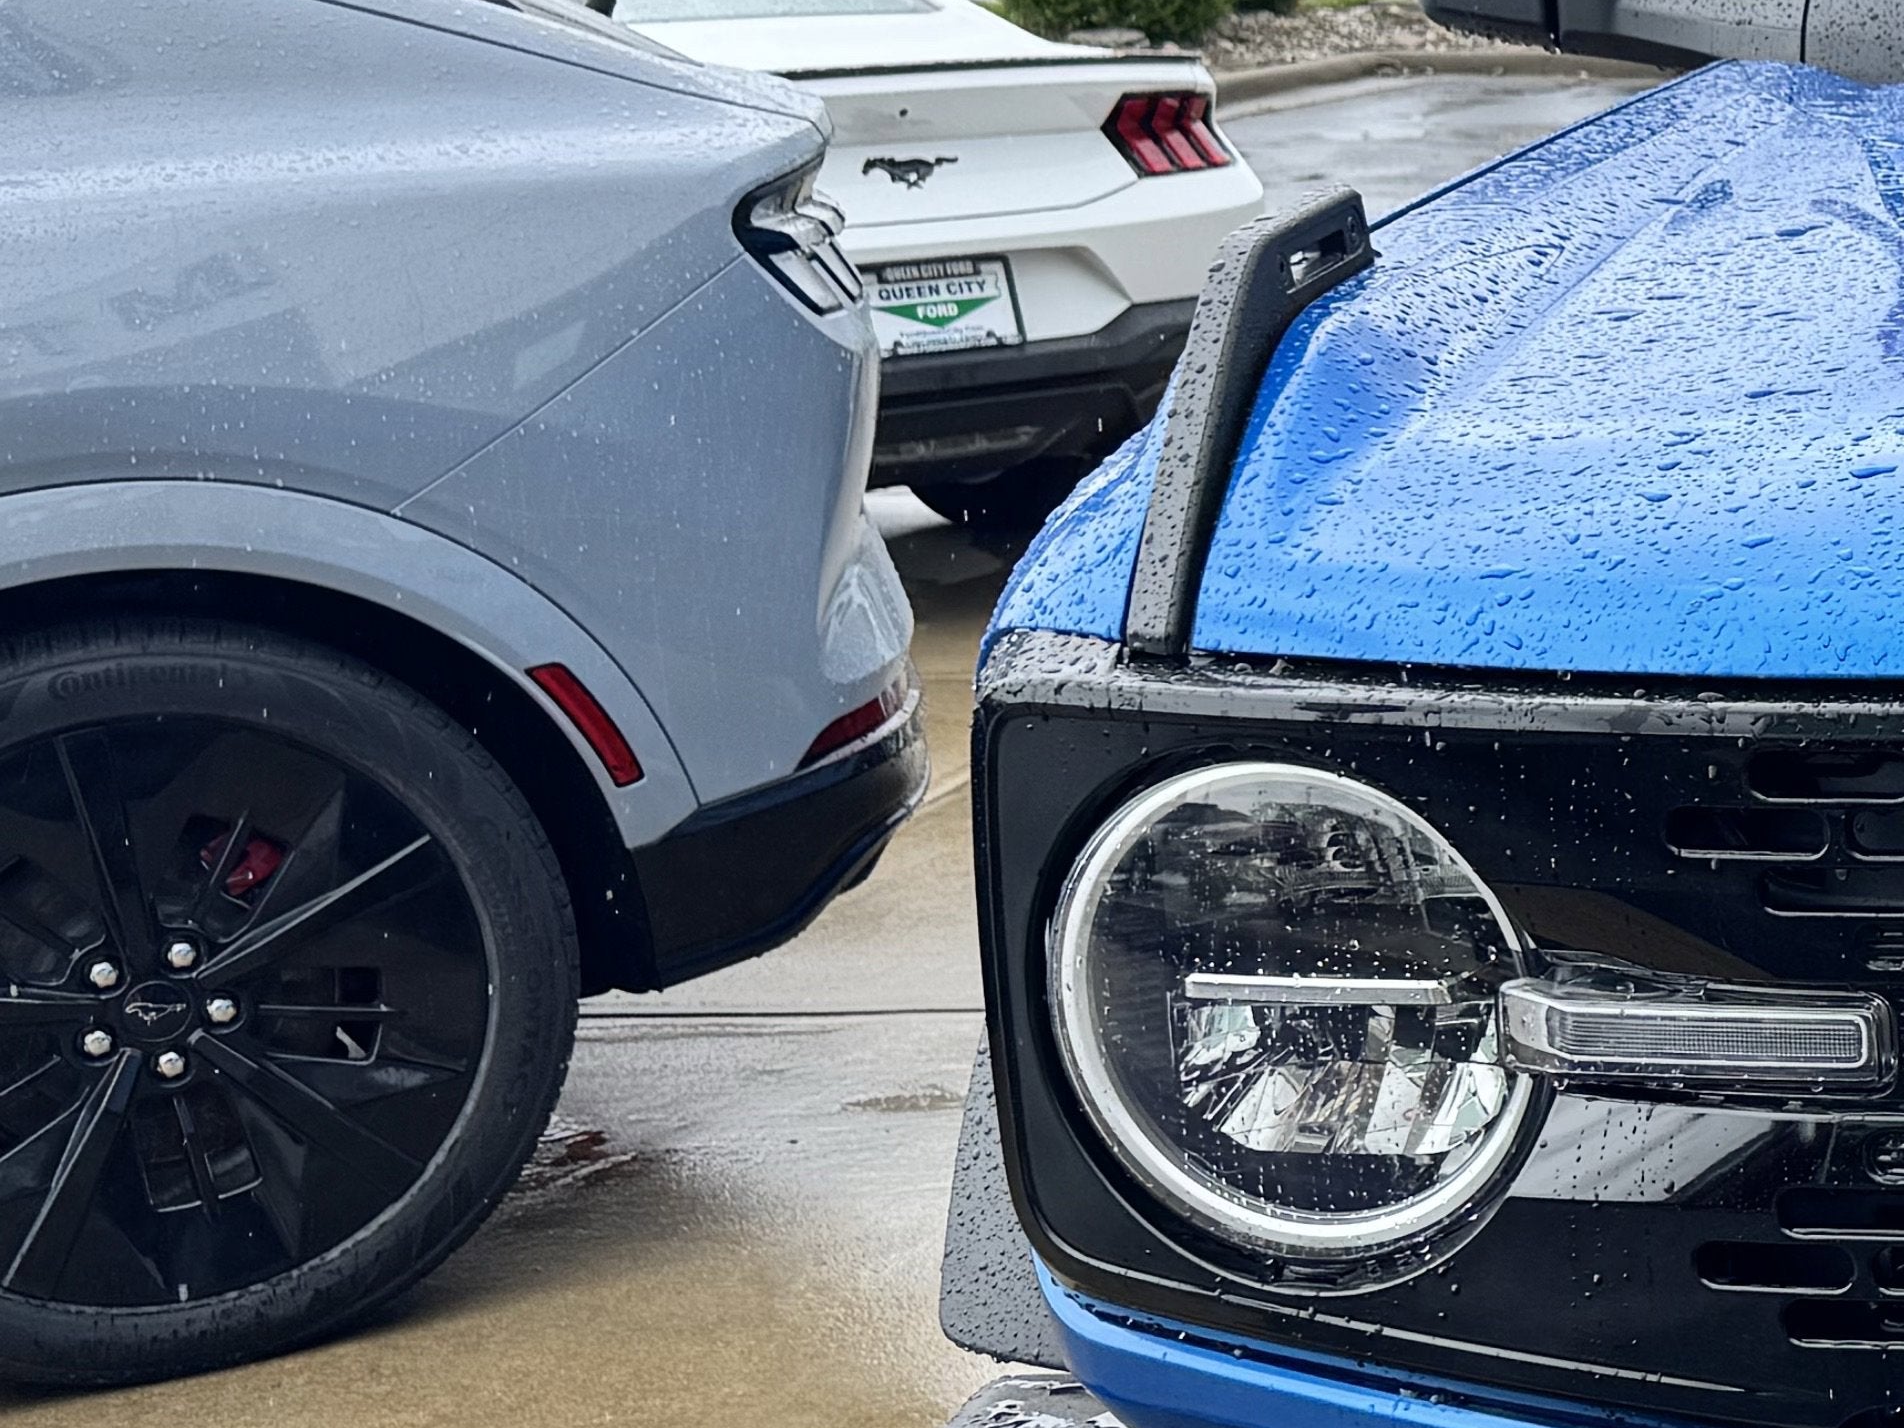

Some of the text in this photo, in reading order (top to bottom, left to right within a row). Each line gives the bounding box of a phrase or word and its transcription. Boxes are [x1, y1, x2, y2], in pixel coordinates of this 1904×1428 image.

[879, 279, 986, 301] QUEEN CITY
[916, 302, 959, 320] FORD
